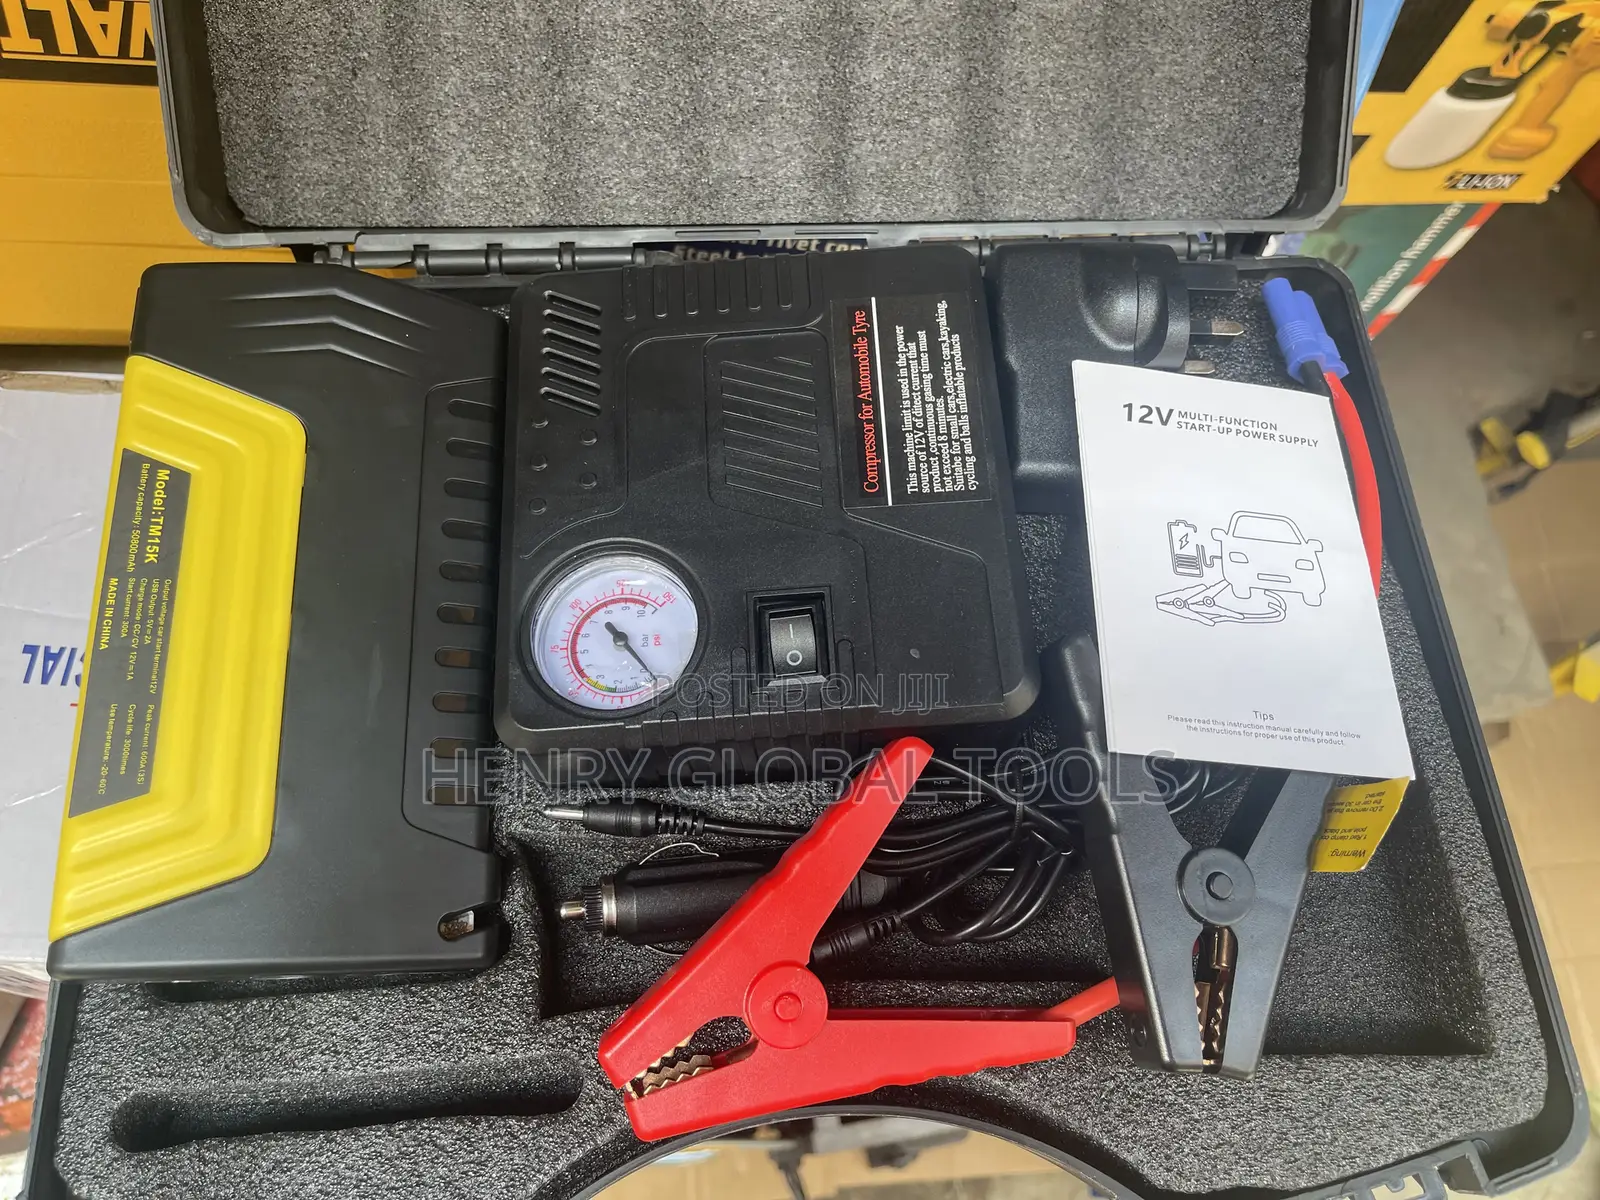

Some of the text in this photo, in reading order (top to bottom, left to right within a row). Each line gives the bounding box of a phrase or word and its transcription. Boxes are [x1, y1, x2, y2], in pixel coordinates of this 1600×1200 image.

[917, 331, 927, 351] must
[919, 353, 929, 372] time
[921, 373, 935, 402] gasing
[851, 311, 880, 492] Compressor for Automobile Tyre
[896, 325, 918, 494] This machine limit is used in the power
[951, 334, 979, 490] cycling and balls inflatable products
[906, 342, 930, 493] source of 12V of ditect current that
[936, 396, 947, 433] minutes.
[1123, 403, 1278, 431] 12V MULTI-FUNCTION
[947, 415, 959, 439] small
[1177, 421, 1319, 448] START-UP POWER SUPPLY
[938, 443, 951, 474] exceed
[950, 441, 960, 454] for
[138, 464, 150, 490] Battery
[929, 457, 944, 493] product
[942, 476, 953, 492] not
[952, 456, 964, 491] Suitabe
[127, 578, 135, 593] Start
[137, 578, 147, 600] Charge
[162, 579, 171, 600] Output
[100, 578, 118, 650] MADE IN CHINA
[637, 610, 646, 618] 10
[131, 624, 141, 648] CC/CV
[641, 634, 649, 648] bar
[653, 633, 661, 646] psi
[22, 644, 85, 688] IAL
[110, 704, 118, 717] Use
[128, 704, 136, 723] Cycle
[146, 705, 154, 721] Peak
[1253, 711, 1275, 721] Tips
[1167, 714, 1193, 724] Please
[1194, 718, 1210, 726] read
[1212, 719, 1226, 727] this
[1227, 720, 1264, 730] instruction
[1266, 724, 1292, 733] manual
[1293, 726, 1324, 737] carefully
[1340, 731, 1361, 739] follow
[1186, 724, 1198, 732] the
[1200, 725, 1242, 736] instructions
[1254, 732, 1278, 741] proper
[1294, 734, 1301, 742] of
[1302, 735, 1315, 743] this
